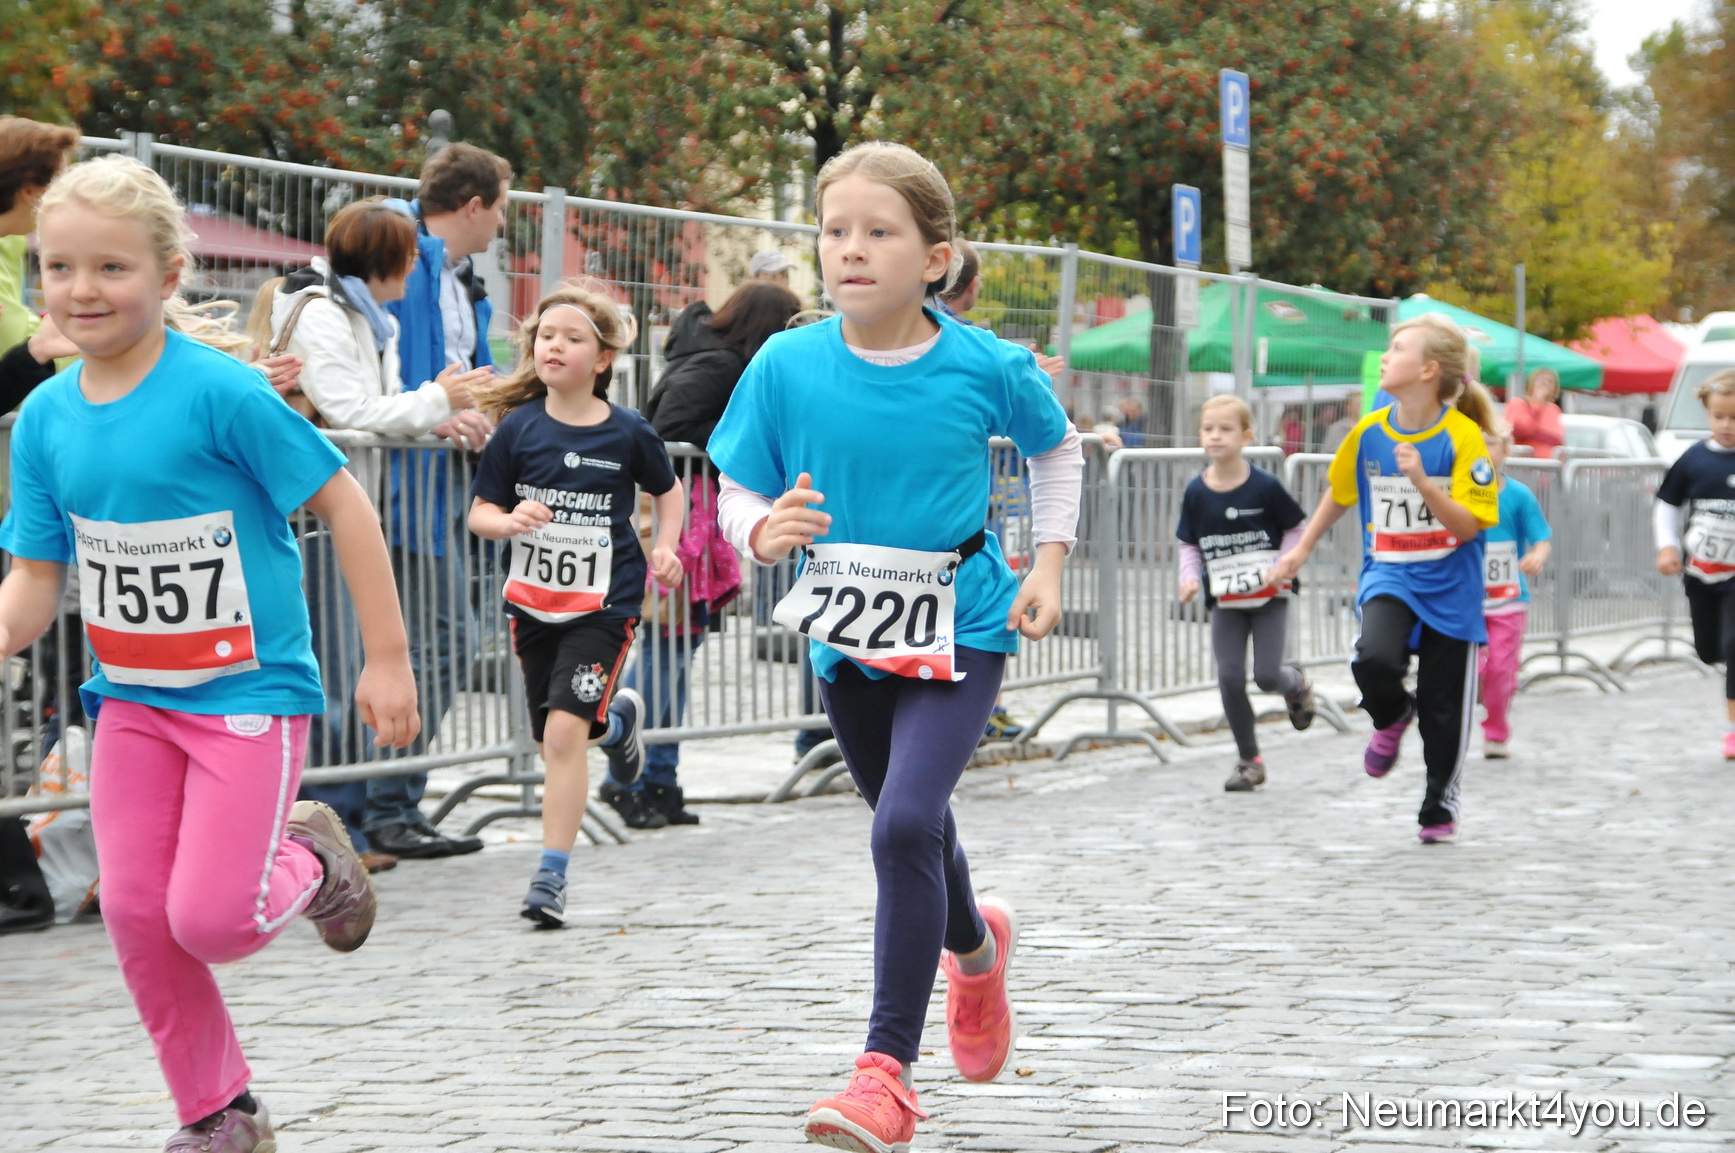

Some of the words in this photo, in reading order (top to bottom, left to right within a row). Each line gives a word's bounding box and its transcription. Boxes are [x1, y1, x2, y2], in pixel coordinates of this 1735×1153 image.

[1227, 80, 1244, 134] P
[1179, 196, 1195, 252] P
[515, 483, 612, 511] GRUNDSCHULE
[1381, 498, 1435, 527] 714
[76, 532, 115, 554] PARTL
[117, 537, 206, 556] Neumarkt
[542, 533, 594, 546] Neumarkt
[1695, 531, 1735, 559] 757
[520, 541, 597, 587] 7561
[806, 560, 844, 576] PARTL
[848, 561, 933, 584] Neumarkt
[1488, 558, 1510, 581] 81
[86, 558, 225, 624] 7557
[1220, 568, 1262, 594] 751
[798, 586, 939, 649] 7220
